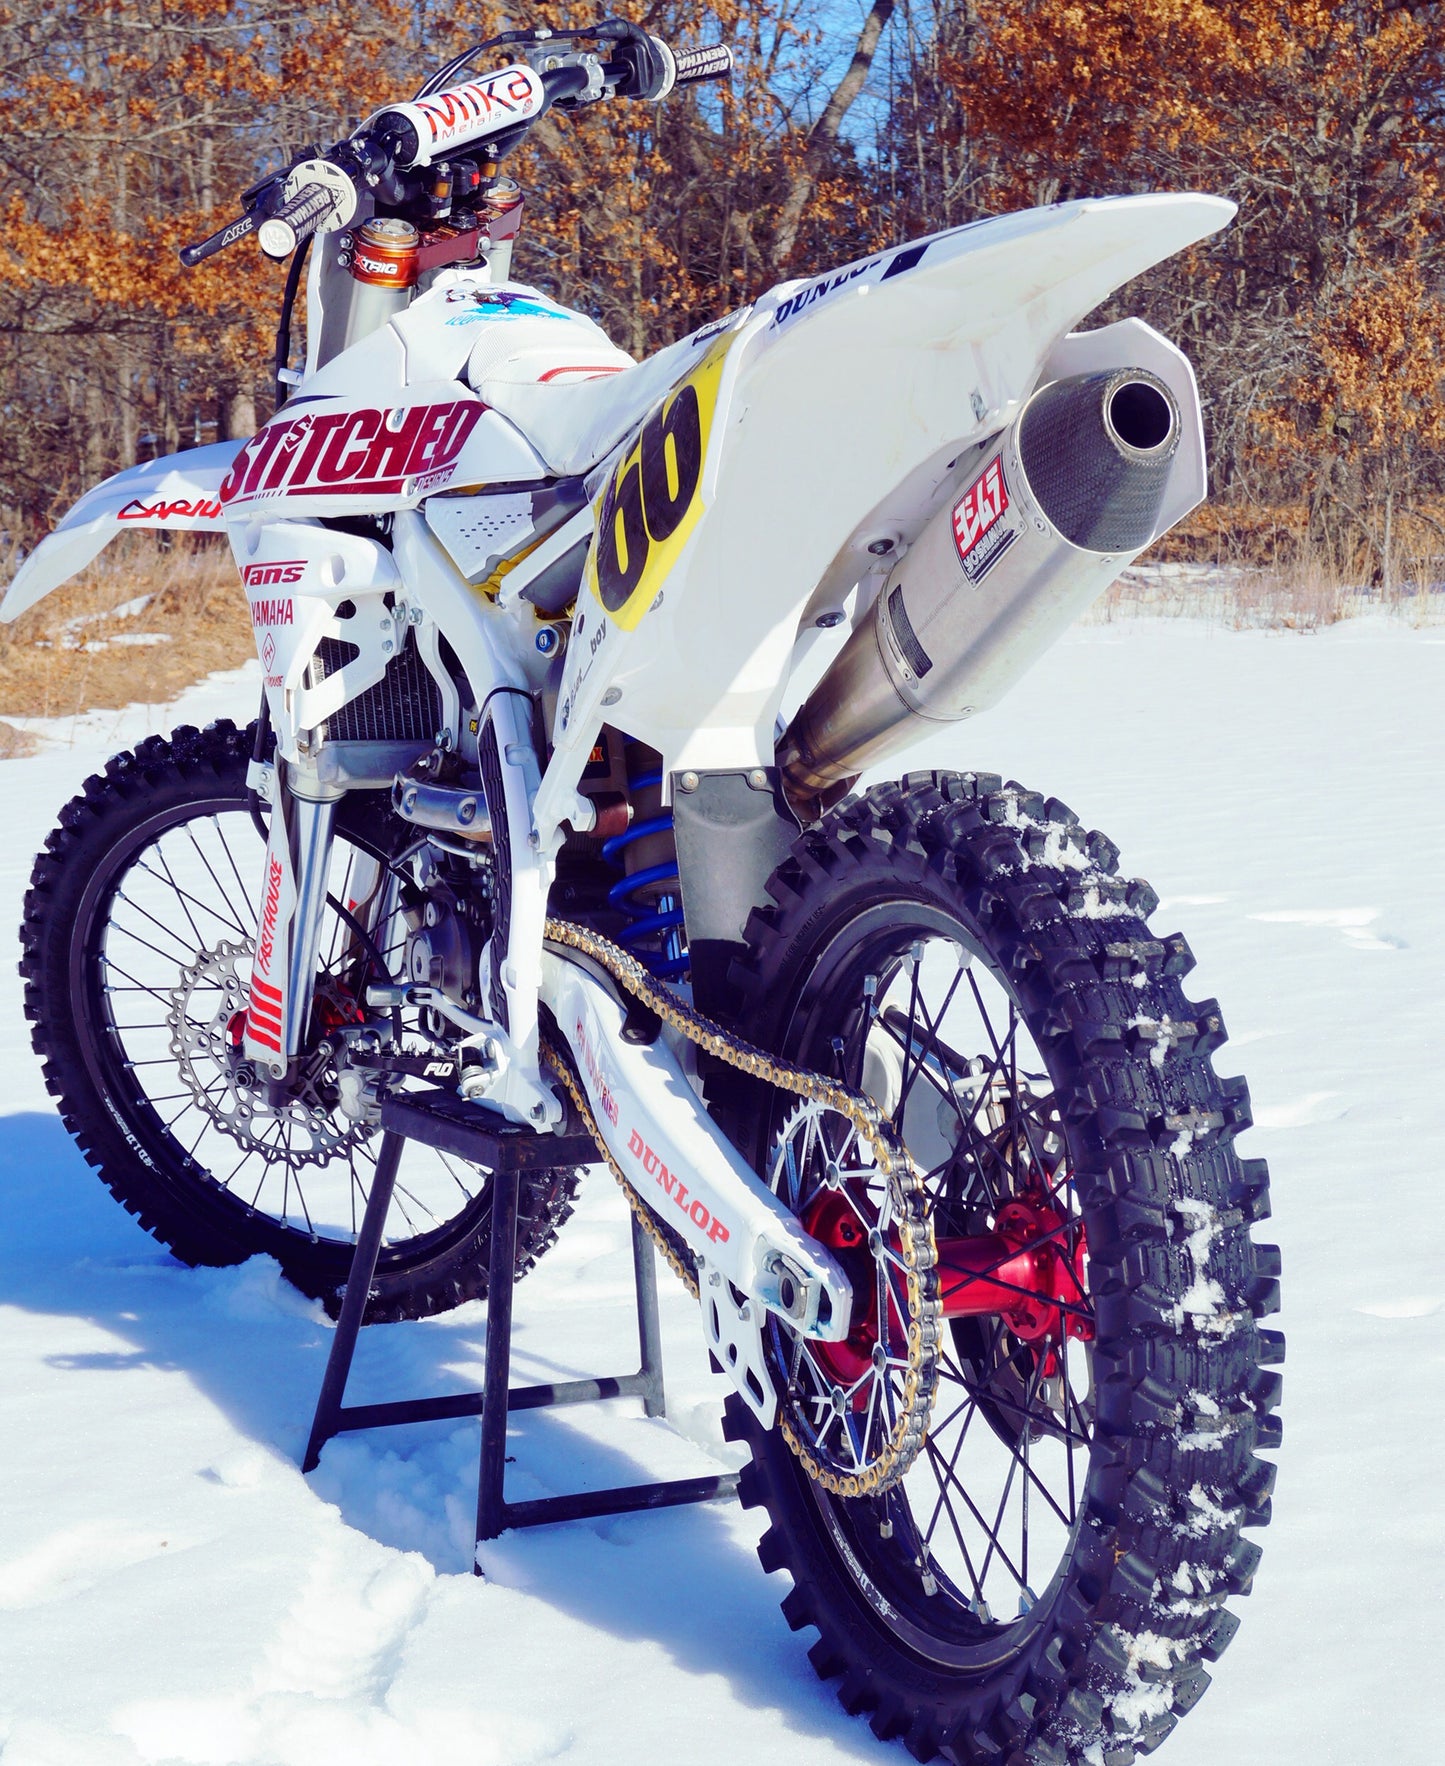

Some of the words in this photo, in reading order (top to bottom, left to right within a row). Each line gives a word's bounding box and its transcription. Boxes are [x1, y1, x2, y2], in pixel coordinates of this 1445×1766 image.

[677, 46, 728, 72] RENTHA
[221, 217, 254, 247] ARC
[353, 252, 398, 276] XTRIG
[769, 258, 881, 331] DUNL
[219, 399, 492, 503] STITCHED
[116, 499, 224, 521] DARIU
[597, 385, 702, 612] 66
[240, 560, 308, 587] Vans
[251, 598, 294, 628] YAMAHA
[257, 851, 282, 977] FASTHOUSE
[423, 1062, 454, 1077] FLO
[626, 1127, 731, 1244] DUNLOP
